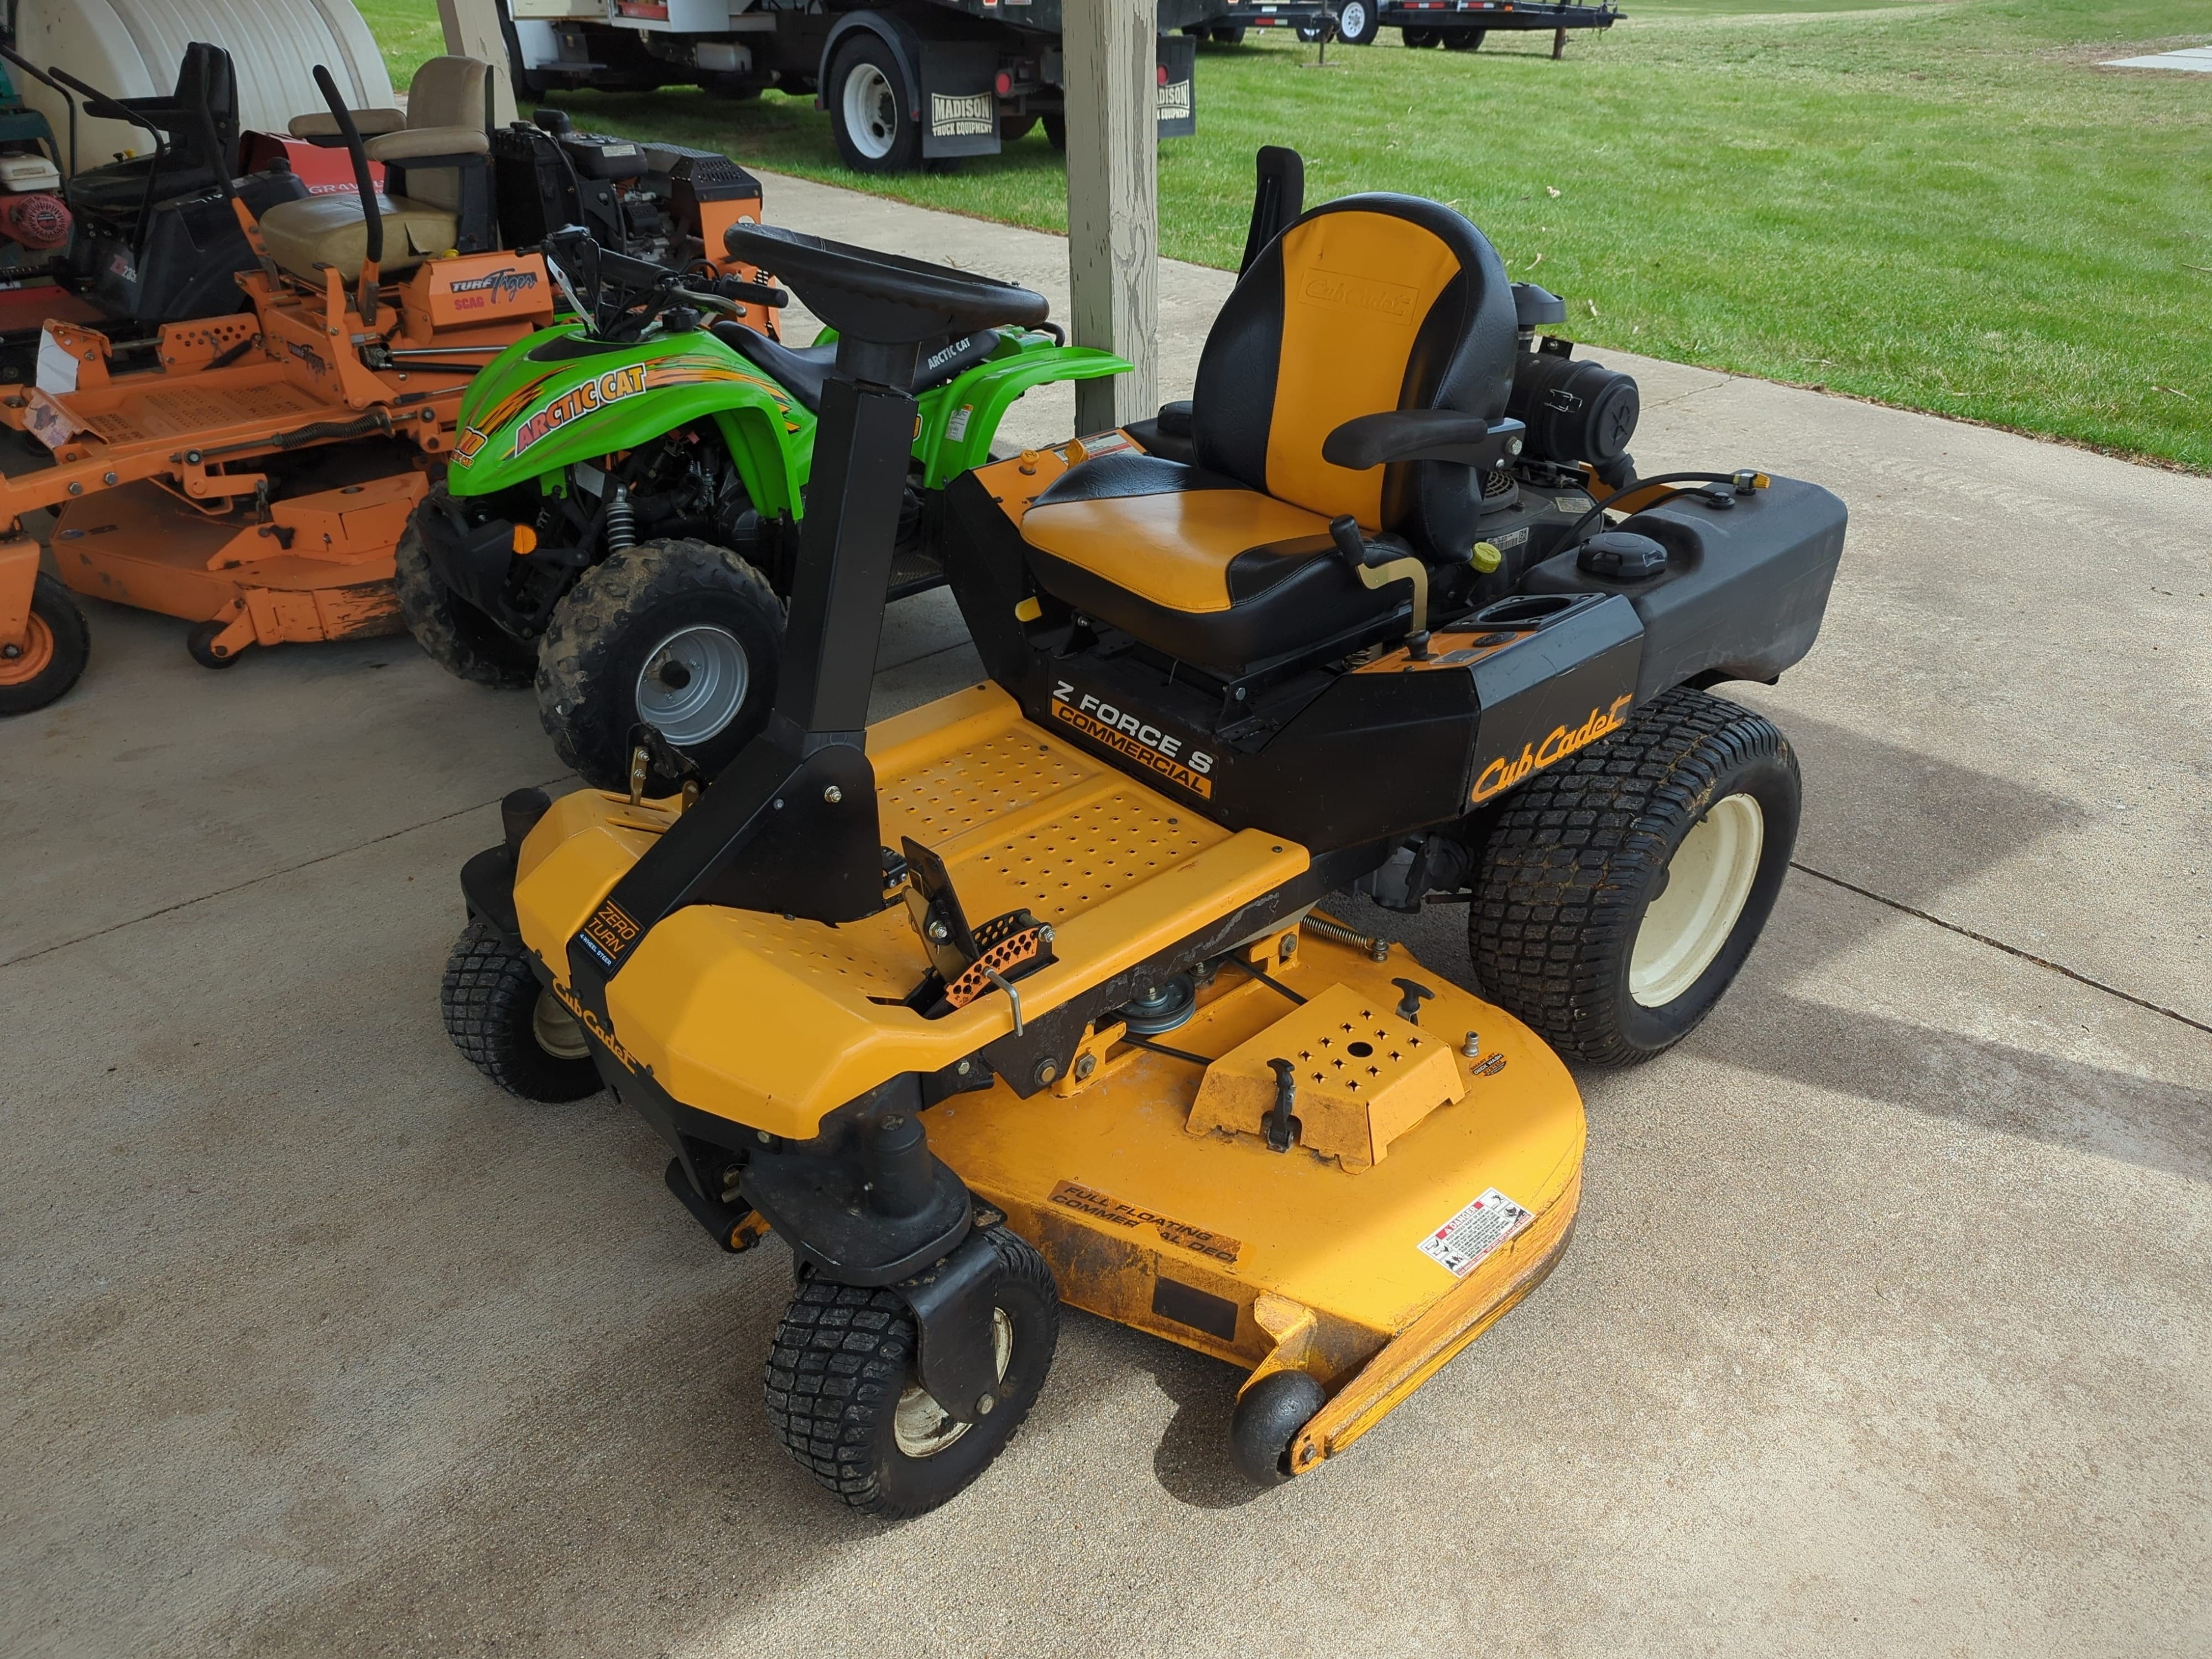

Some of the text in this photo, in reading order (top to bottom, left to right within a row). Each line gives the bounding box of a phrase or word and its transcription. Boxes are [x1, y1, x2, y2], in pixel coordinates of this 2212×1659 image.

[935, 96, 989, 122] MADISON
[1157, 84, 1187, 105] DISON
[932, 121, 993, 137] TRUCK EQUIPMENT
[452, 278, 492, 291] TURF
[454, 296, 484, 310] SCAG
[927, 337, 971, 370] ARCTIC CAT
[515, 363, 646, 458] ARCTIC CAT
[1053, 680, 1213, 774] Z FORCE S
[1058, 706, 1204, 794] COMMERCIAL
[1472, 693, 1632, 802] Cub Cadet
[588, 917, 625, 952] TURN
[598, 906, 636, 940] ZERO
[580, 933, 612, 967] 4-WHEEL STEER
[552, 978, 637, 1076] Cub Cadet
[1473, 1053, 1503, 1075] DECK WASH
[1051, 1194, 1180, 1244] COMMERAL
[1065, 1186, 1213, 1241] FULL FLOATING
[1448, 1205, 1479, 1229] DANGER
